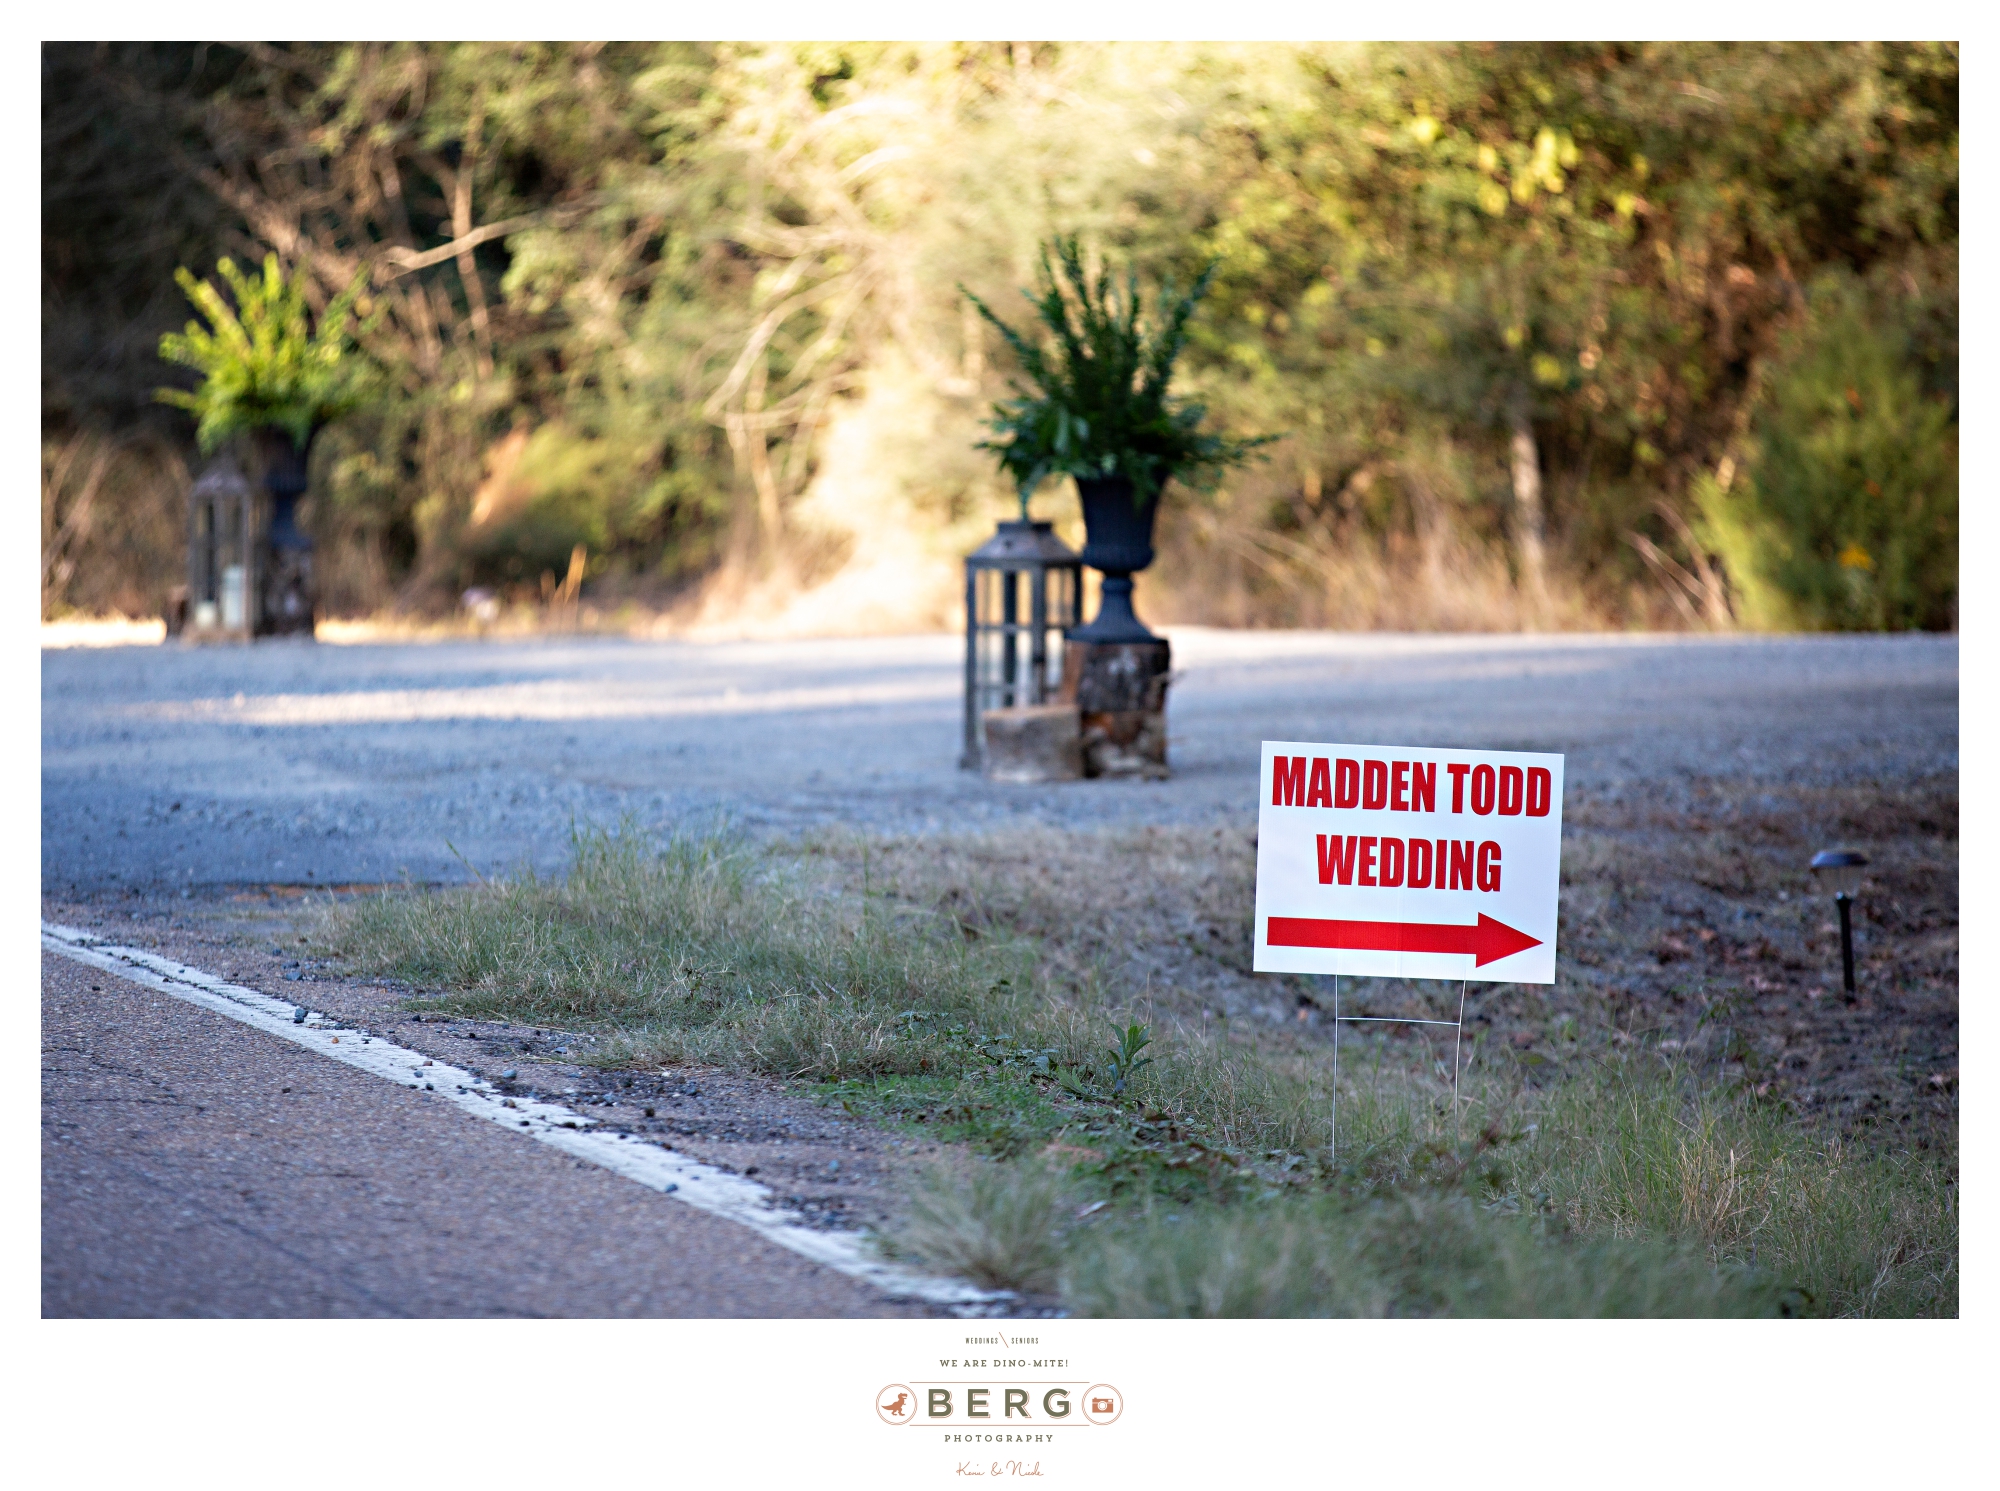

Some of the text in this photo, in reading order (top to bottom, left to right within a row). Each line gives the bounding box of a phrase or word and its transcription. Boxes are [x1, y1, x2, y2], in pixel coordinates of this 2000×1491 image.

[1272, 755, 1552, 817] MADDEN TODD
[1316, 833, 1502, 892] WEDDING
